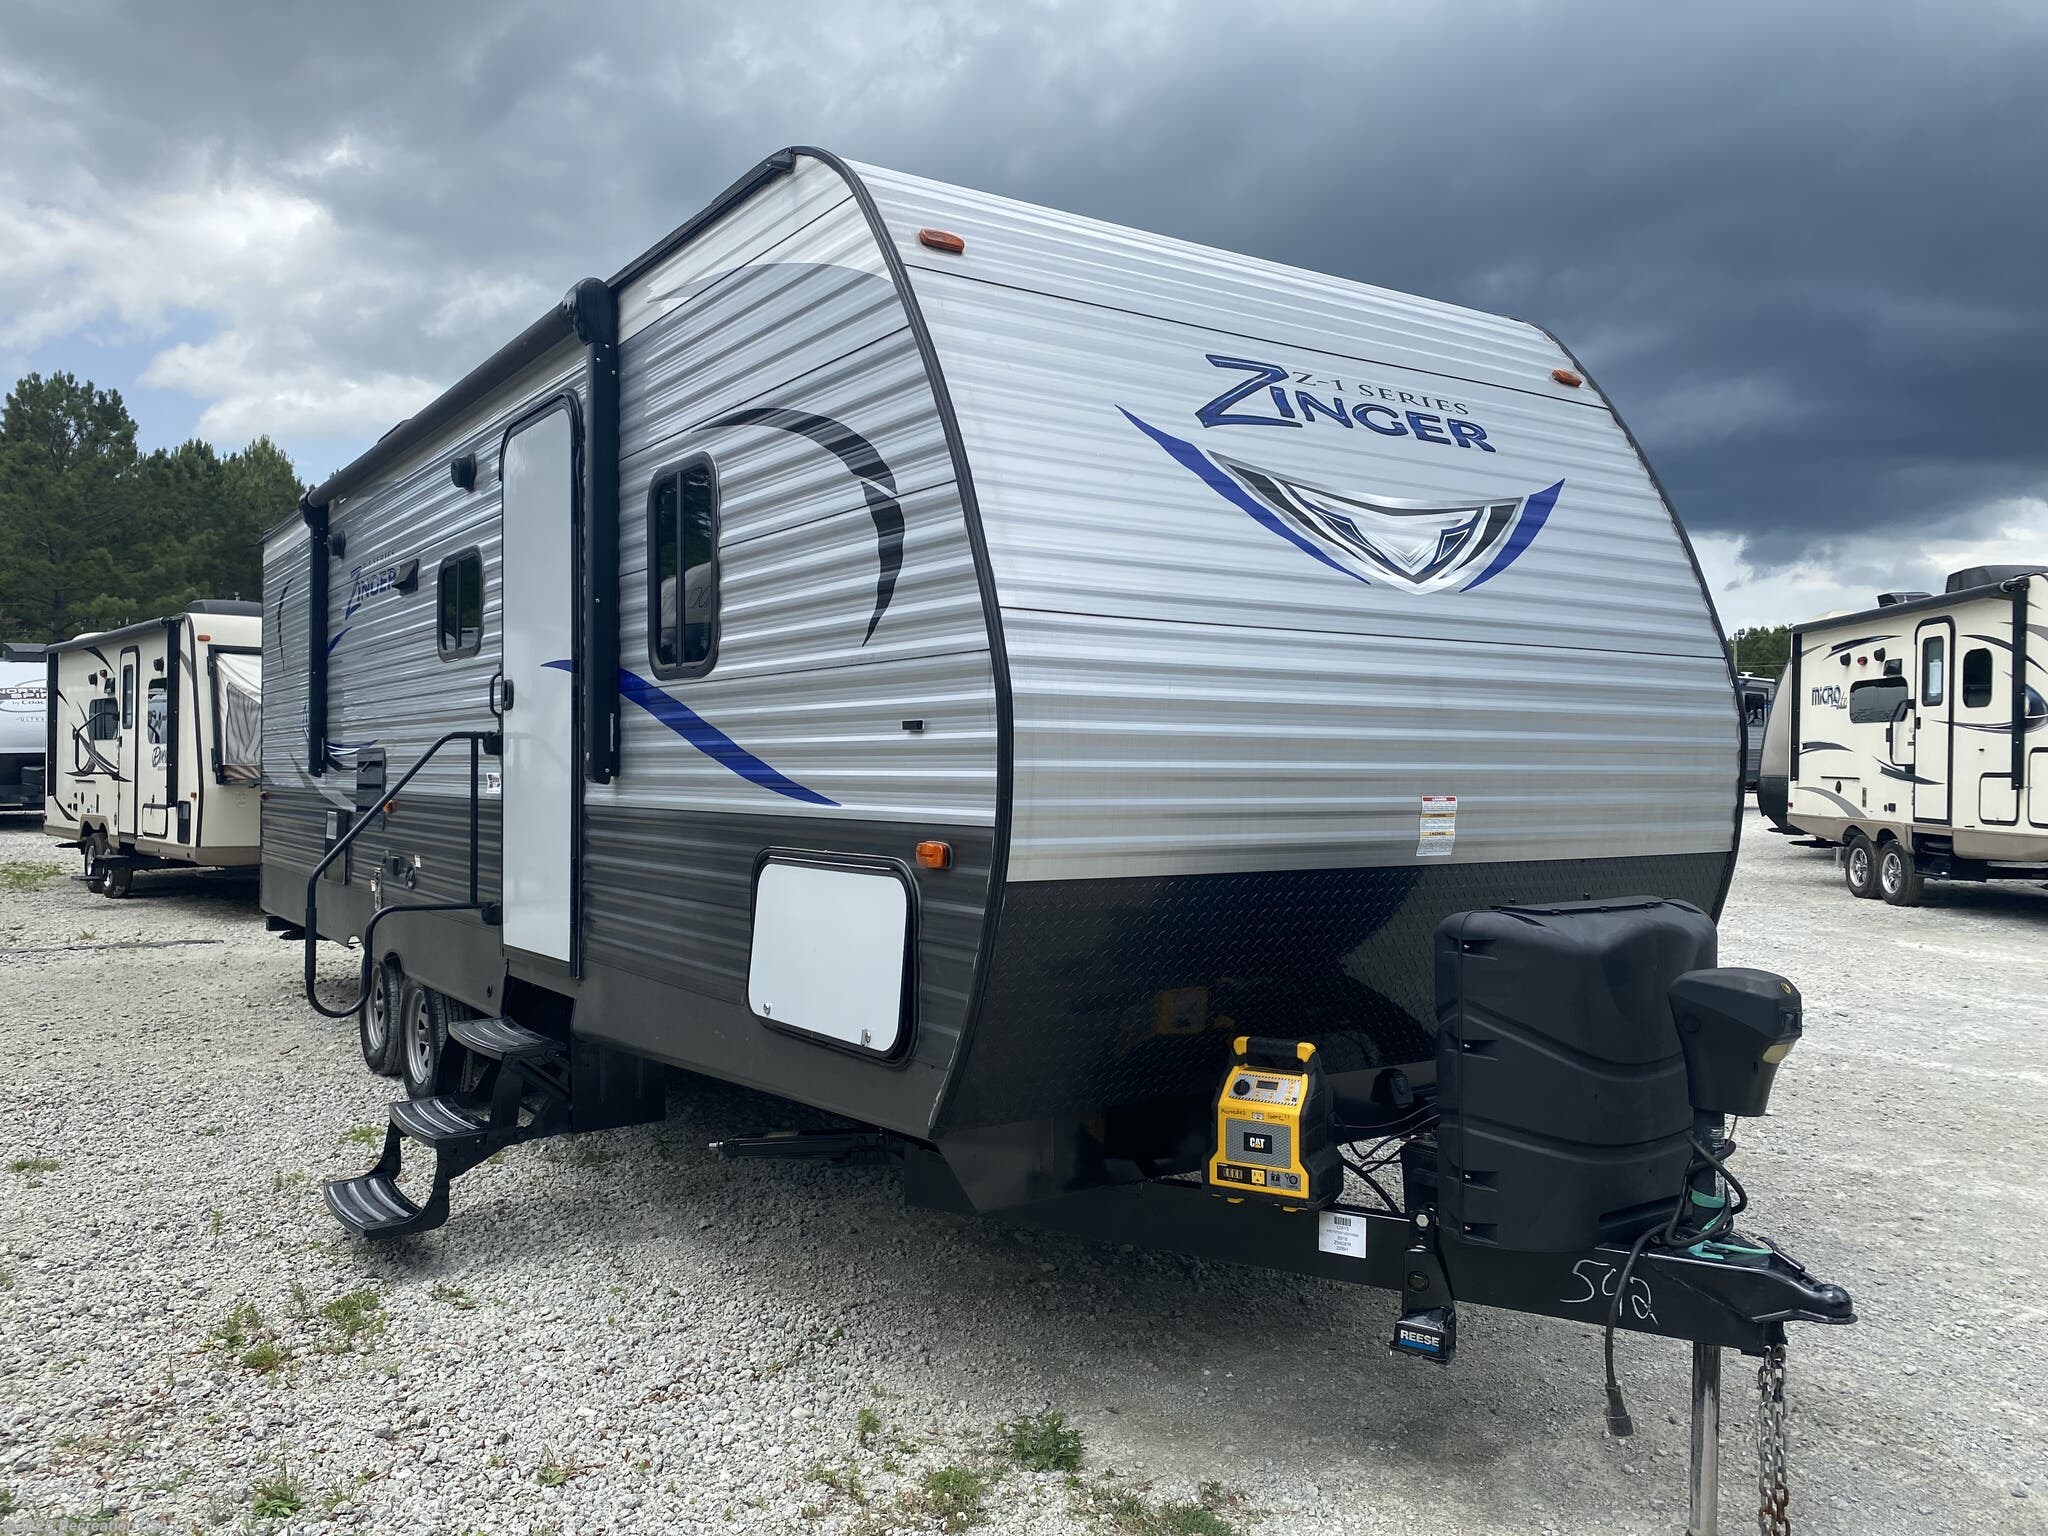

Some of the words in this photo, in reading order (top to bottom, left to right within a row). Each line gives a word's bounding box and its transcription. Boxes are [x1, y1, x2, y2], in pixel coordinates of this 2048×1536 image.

[1195, 353, 1497, 453] ZINGER
[1292, 371, 1345, 392] Z-1
[1358, 384, 1469, 416] SERIES
[345, 565, 397, 621] ZINGER
[1249, 1136, 1265, 1149] CAT
[1400, 1329, 1440, 1347] REESE
